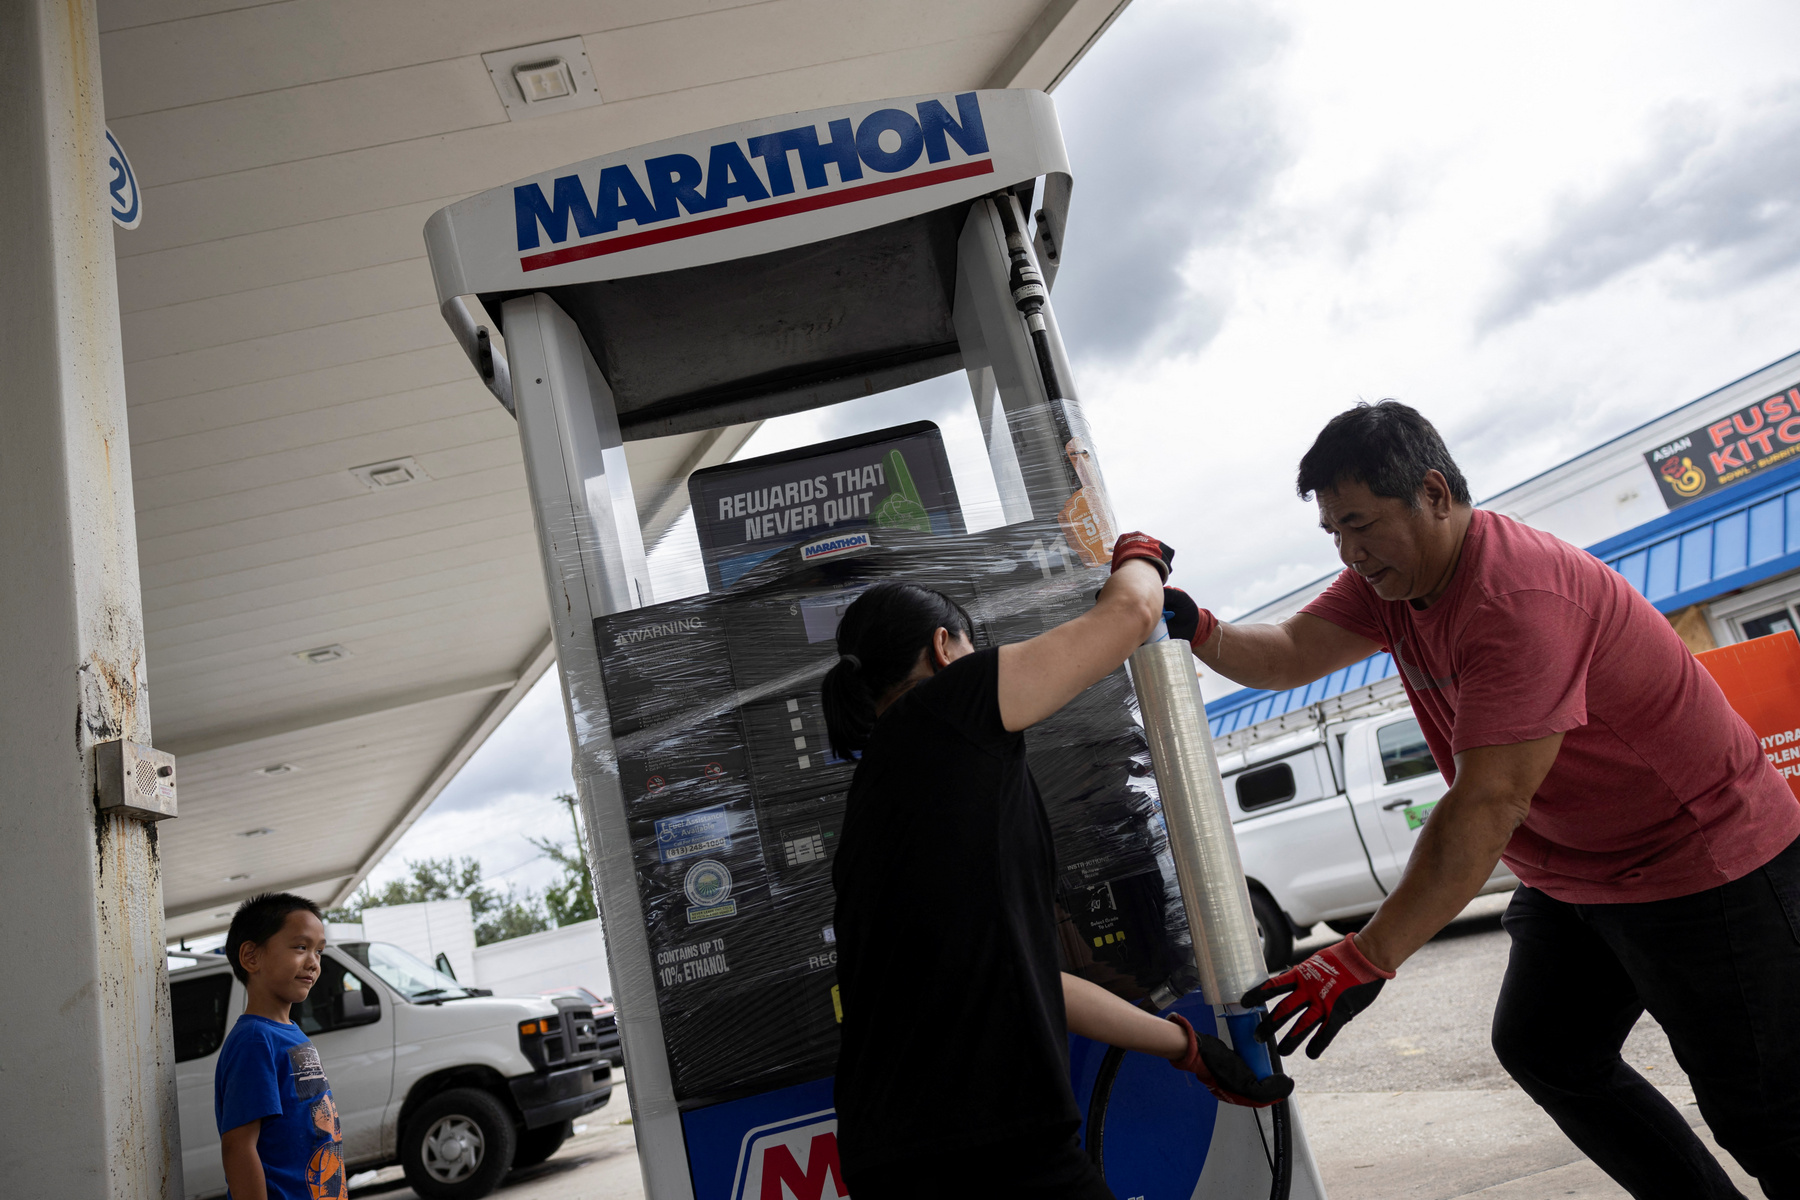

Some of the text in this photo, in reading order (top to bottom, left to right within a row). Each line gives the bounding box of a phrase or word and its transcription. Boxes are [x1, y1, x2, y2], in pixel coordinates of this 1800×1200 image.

[513, 92, 989, 251] MARATHON
[1708, 387, 1800, 448] FUSI
[1653, 437, 1692, 462] ASIAN
[1708, 416, 1800, 475] KITC
[1718, 466, 1751, 485] BOWL
[719, 463, 886, 521] REWARDS THAT
[744, 492, 874, 541] NEVER QUIT
[804, 534, 867, 557] MARATHON
[1026, 533, 1074, 579] 11
[790, 605, 798, 616] $
[628, 616, 702, 643] WARNING
[1767, 746, 1800, 764] PLEN
[668, 812, 724, 830] Fuel Assistance
[680, 822, 715, 836] Available
[657, 938, 724, 965] CONTAINS UP TO
[659, 954, 729, 988] 10% ETHANOL
